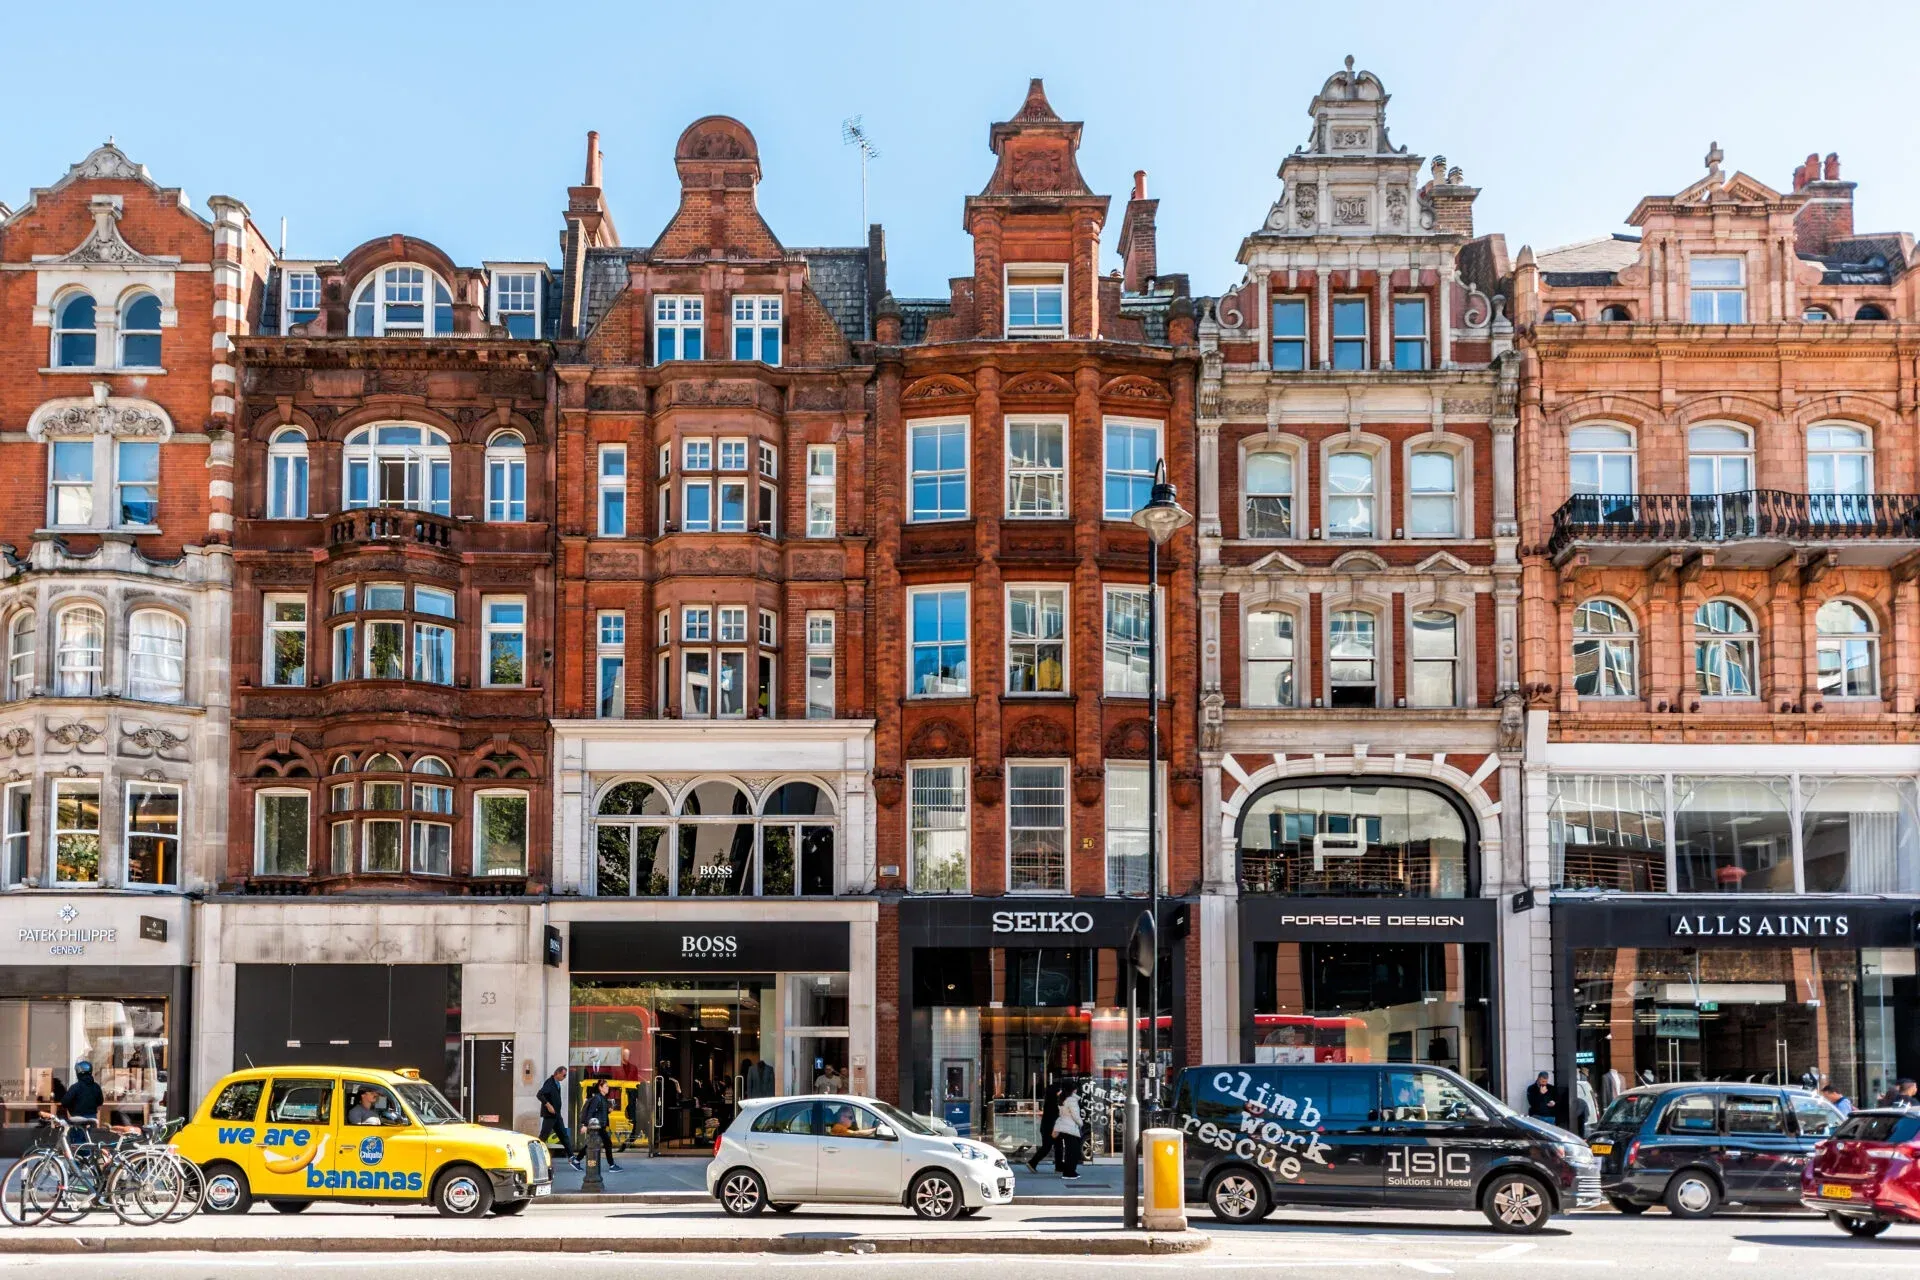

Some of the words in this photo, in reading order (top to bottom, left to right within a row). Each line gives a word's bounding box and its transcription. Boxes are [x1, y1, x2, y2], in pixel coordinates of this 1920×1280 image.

[700, 865, 733, 875] BOSS
[992, 911, 1094, 933] SEIKO
[1281, 915, 1381, 926] PORSCHE
[1387, 915, 1464, 926] DESIGN
[1674, 915, 1849, 935] ALLSAINTS
[18, 929, 58, 942] PATEK
[60, 929, 117, 942] PHILIPPE
[49, 945, 84, 955] GENEVE
[681, 935, 737, 952] BOSS
[480, 992, 497, 1005] 53
[500, 1041, 513, 1054] K
[218, 1127, 255, 1144] we
[263, 1128, 311, 1146] are
[306, 1162, 423, 1191] bananas
[1388, 1177, 1431, 1185] Solutions
[1445, 1179, 1472, 1187] Metal
